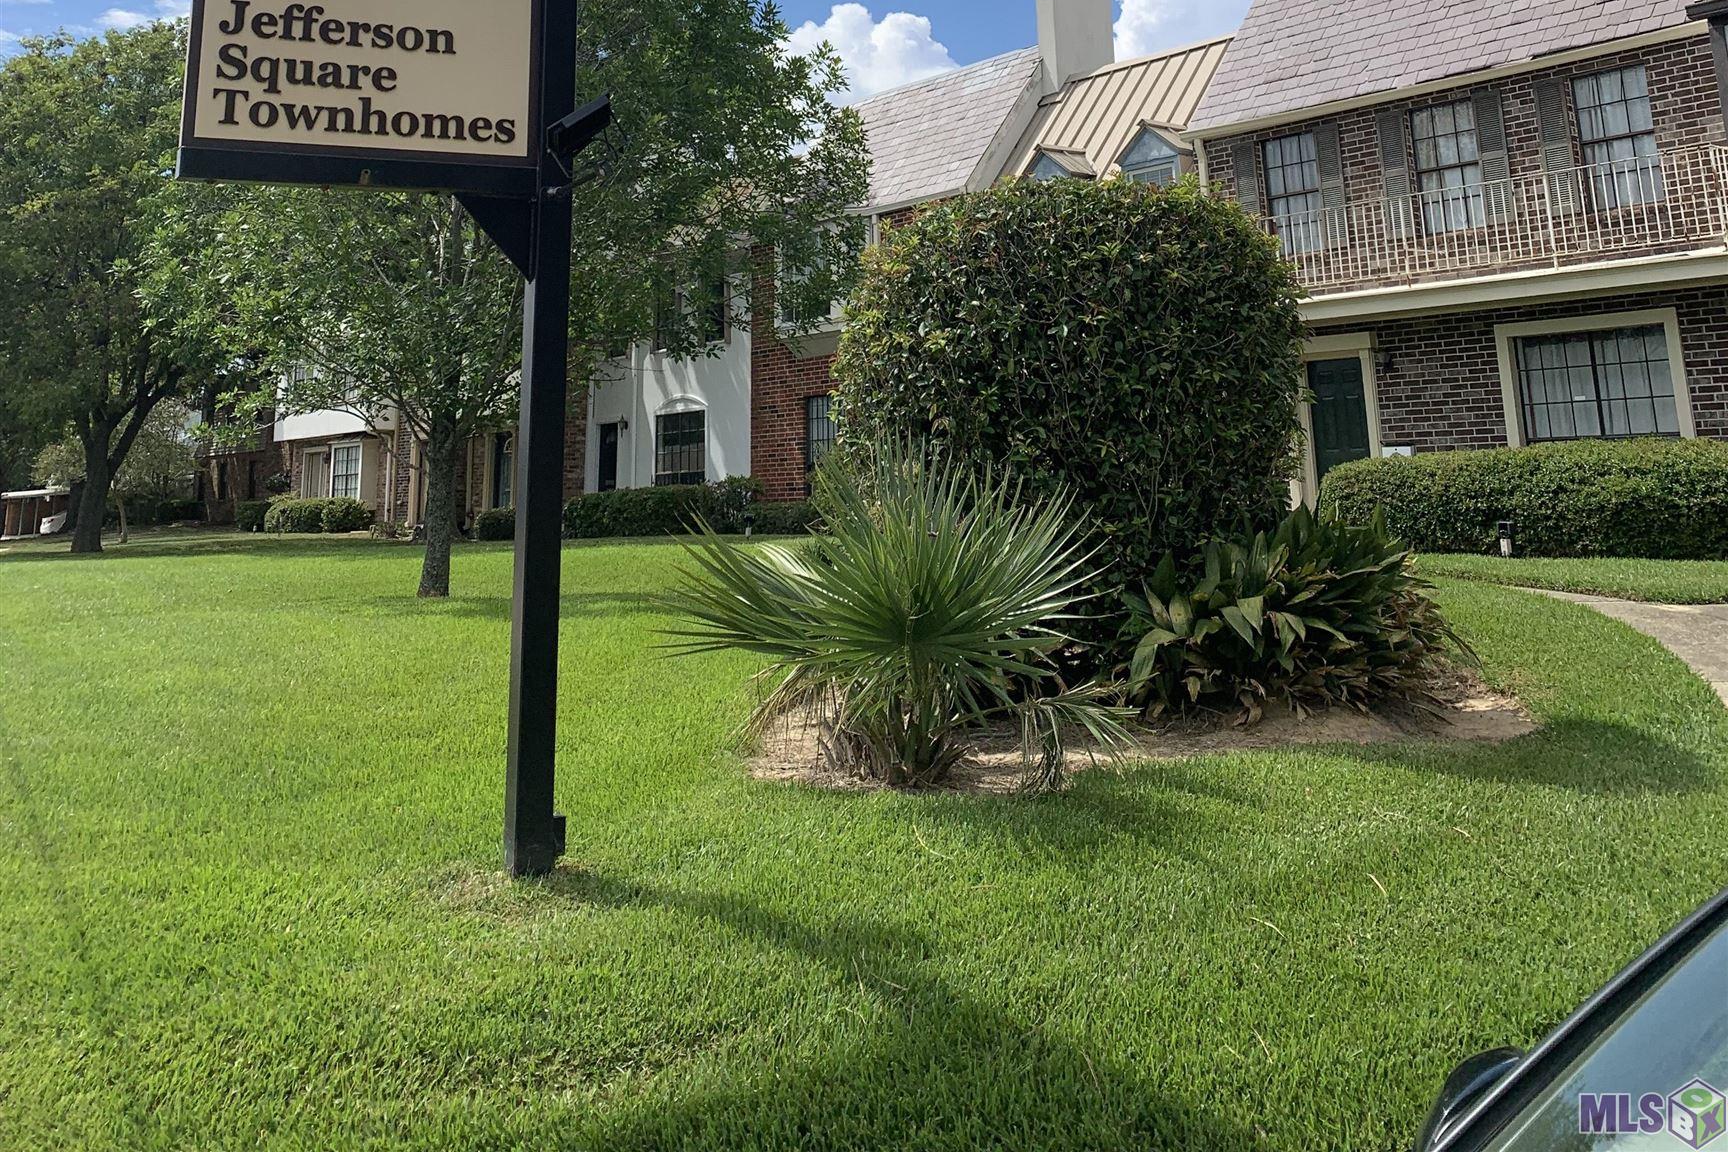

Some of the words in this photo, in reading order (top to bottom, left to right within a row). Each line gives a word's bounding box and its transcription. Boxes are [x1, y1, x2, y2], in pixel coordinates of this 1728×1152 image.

[218, 0, 457, 55] Jefferson
[215, 42, 398, 95] Square
[212, 88, 517, 144] Townhomes
